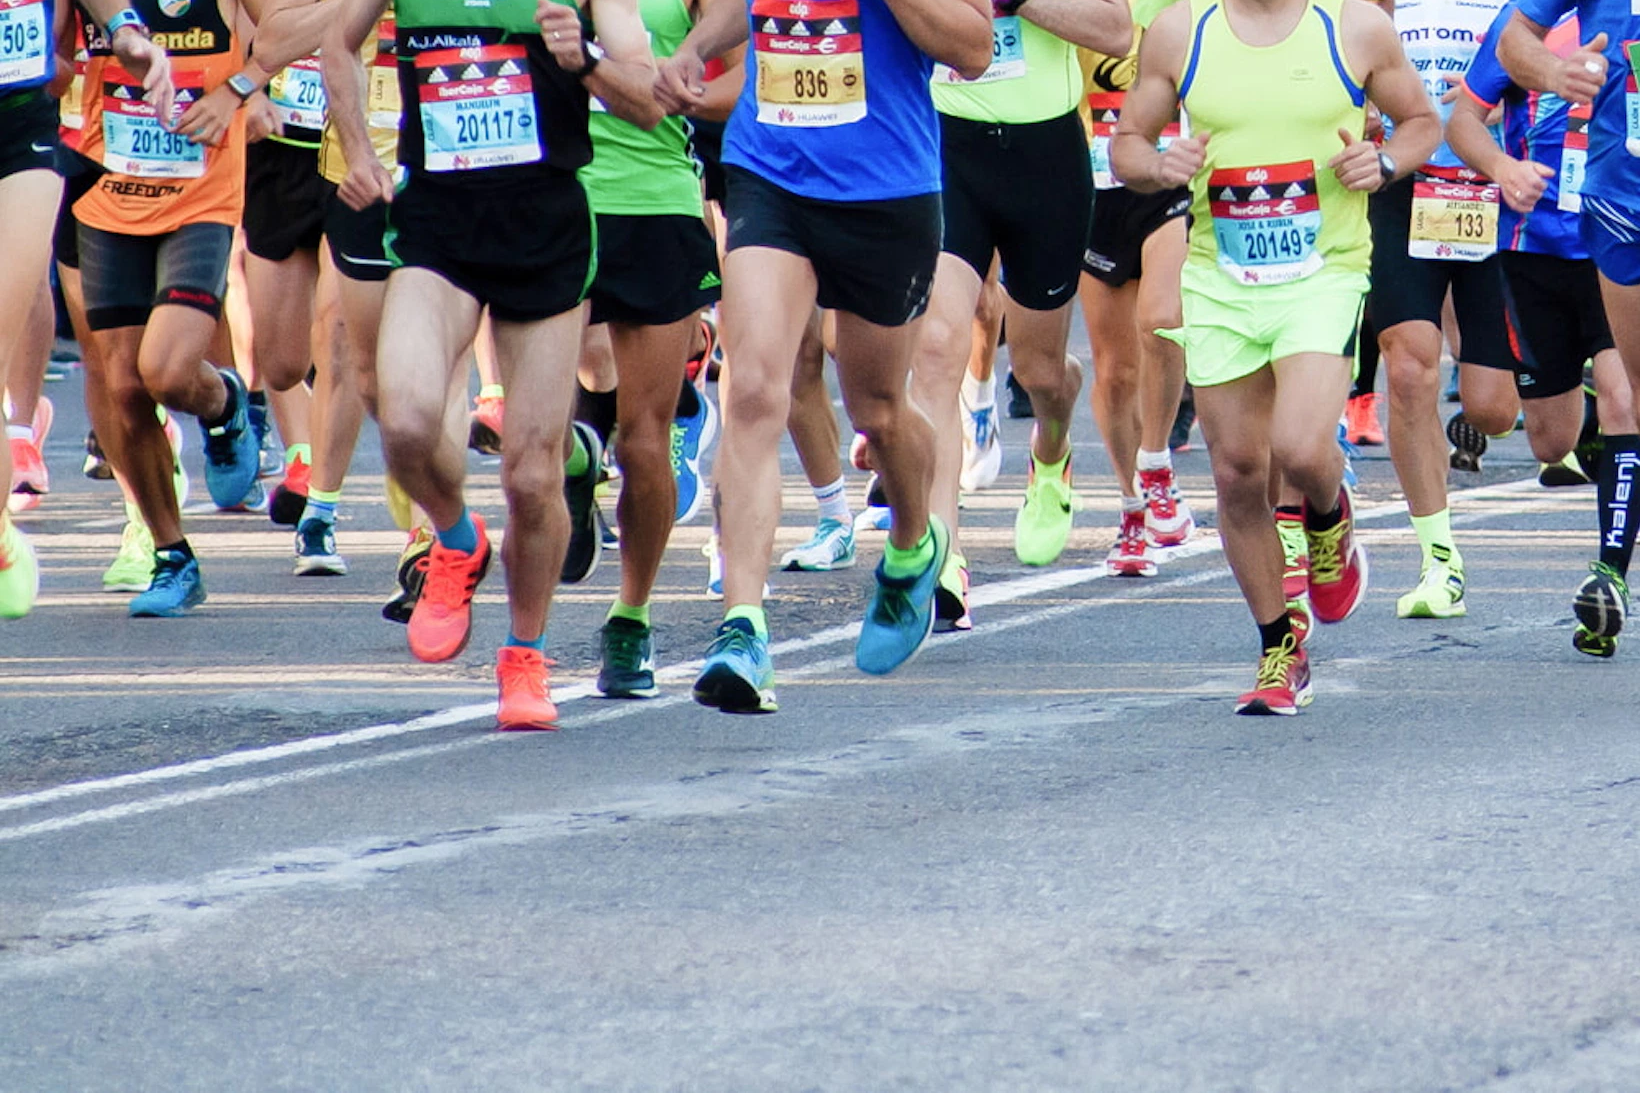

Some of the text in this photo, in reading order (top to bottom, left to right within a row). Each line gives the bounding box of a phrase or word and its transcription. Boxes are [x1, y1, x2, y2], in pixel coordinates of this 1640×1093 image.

[794, 69, 829, 98] 836
[456, 109, 515, 145] 20117
[131, 128, 184, 156] 20136
[1455, 211, 1484, 238] 133
[1244, 228, 1303, 259] 20149
